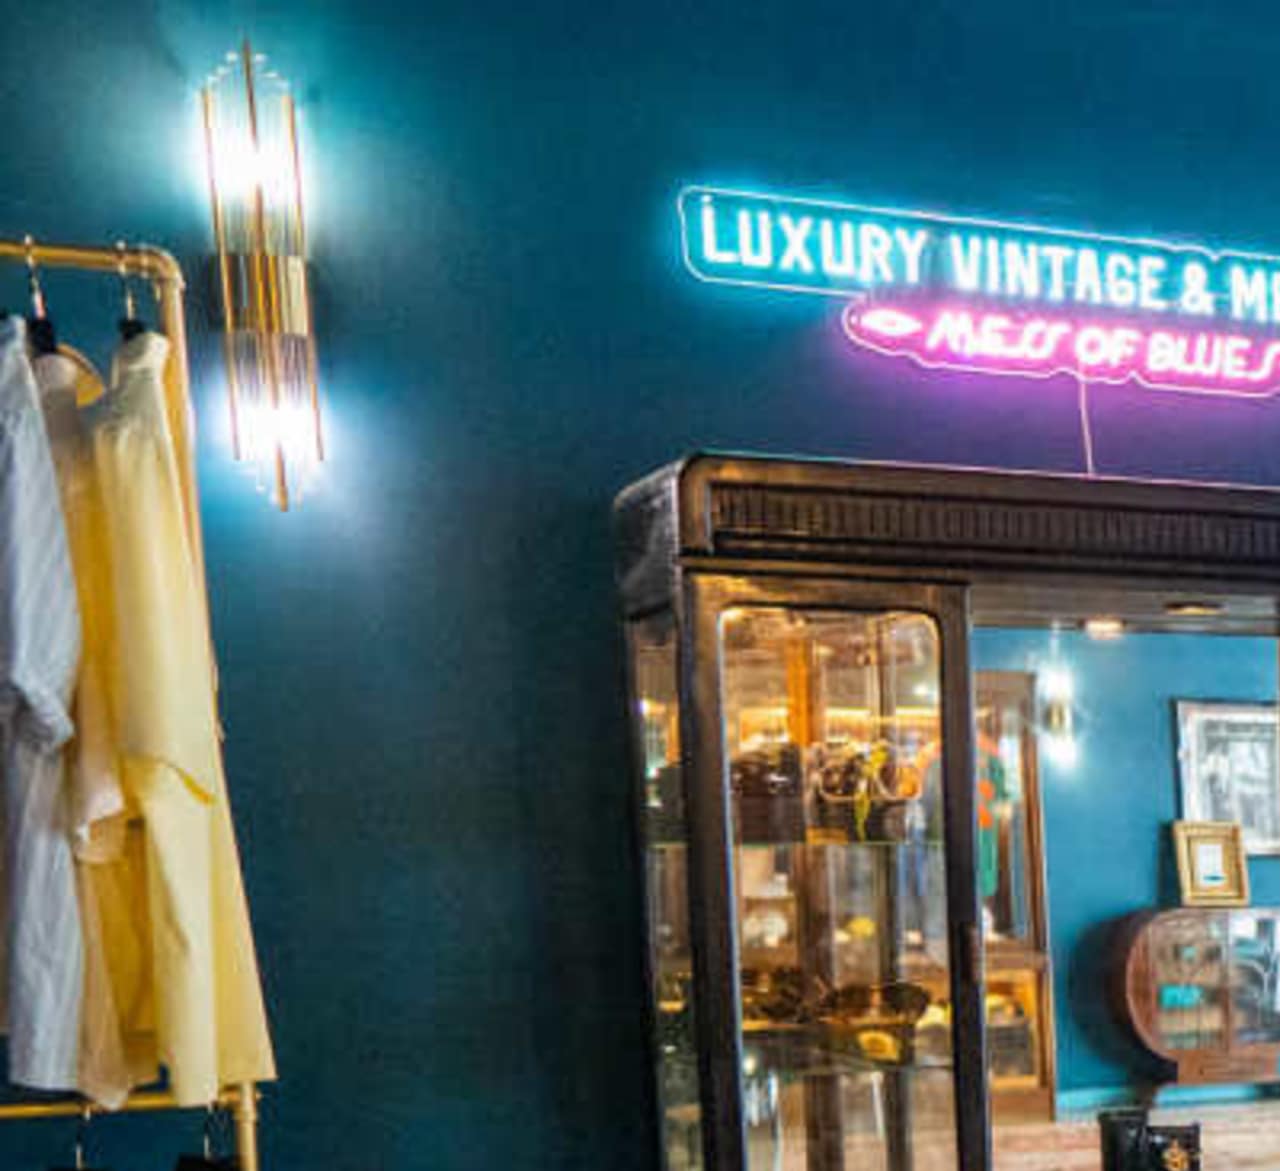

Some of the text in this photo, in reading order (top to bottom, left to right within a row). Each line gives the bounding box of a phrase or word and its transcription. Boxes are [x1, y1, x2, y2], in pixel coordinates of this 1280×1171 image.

[702, 196, 927, 284] LUXURY
[948, 232, 1167, 309] VINTAGE
[1181, 261, 1214, 315] &
[925, 310, 1072, 360] MESS
[1074, 325, 1141, 367] OF
